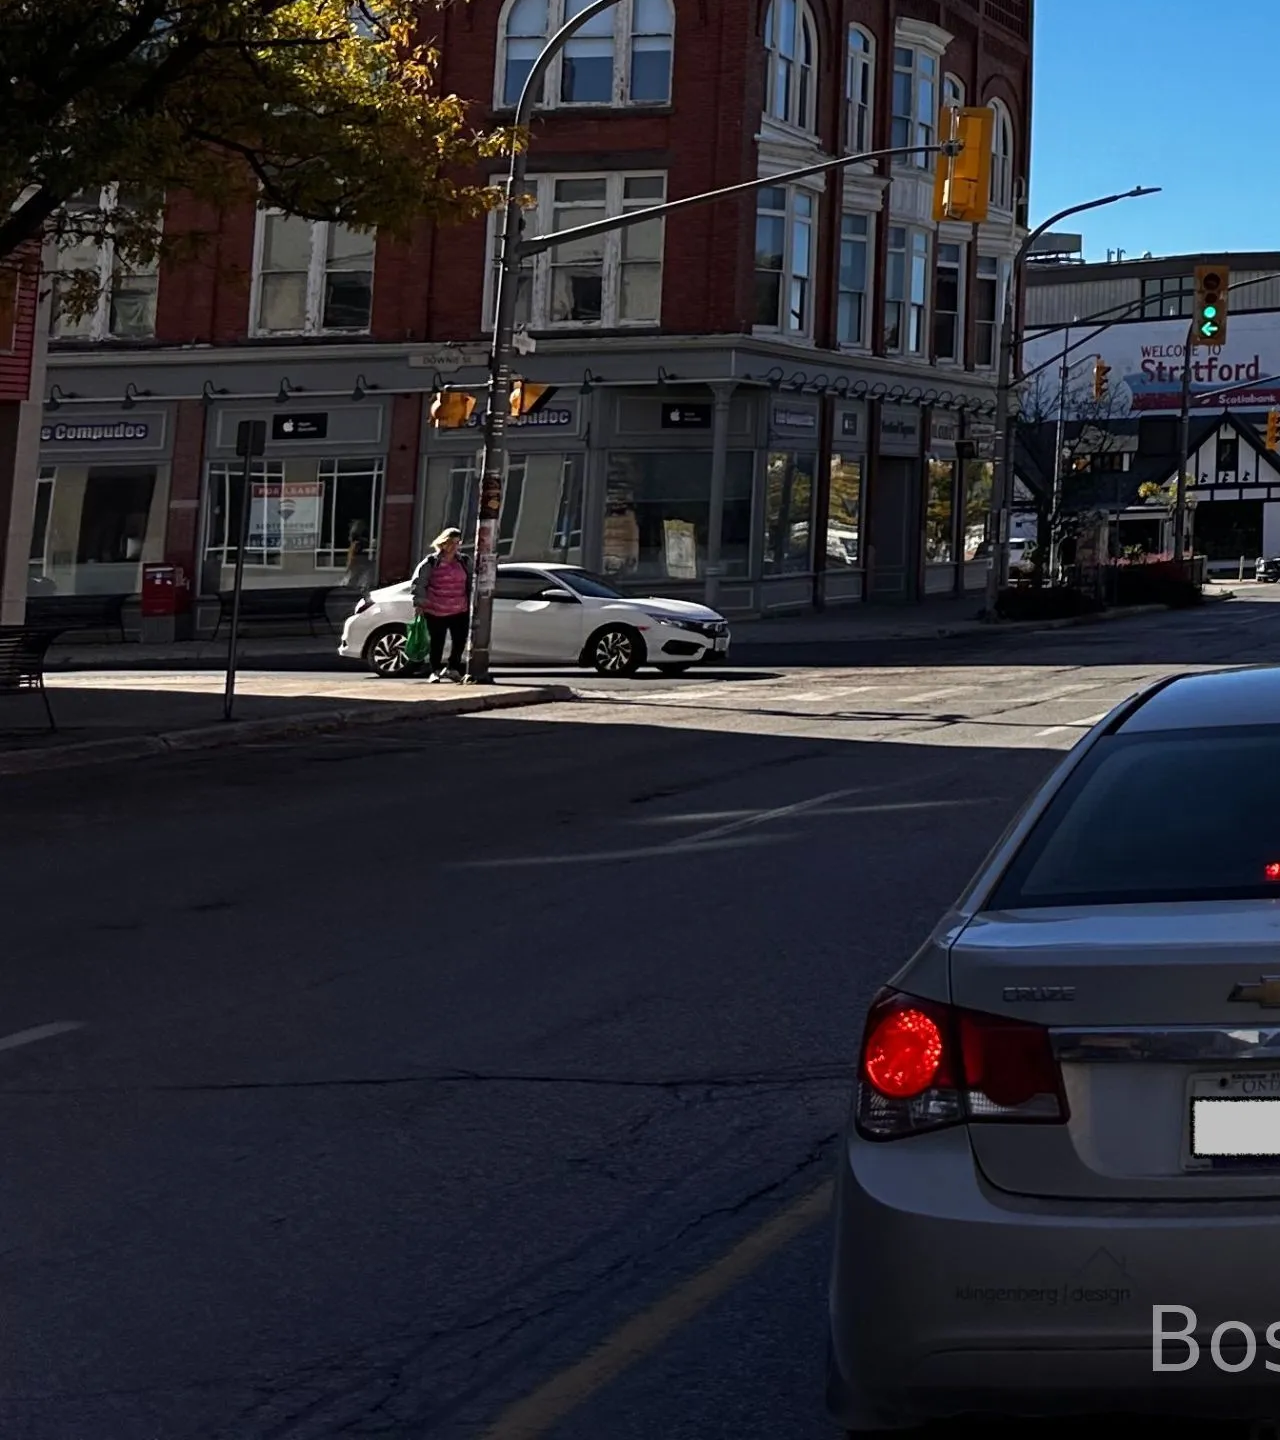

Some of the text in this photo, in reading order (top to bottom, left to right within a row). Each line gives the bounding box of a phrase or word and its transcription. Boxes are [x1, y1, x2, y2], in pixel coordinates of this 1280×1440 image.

[1219, 393, 1277, 405] Scotiabank
[55, 423, 148, 441] Compudoc
[1003, 986, 1076, 1002] CRUZE
